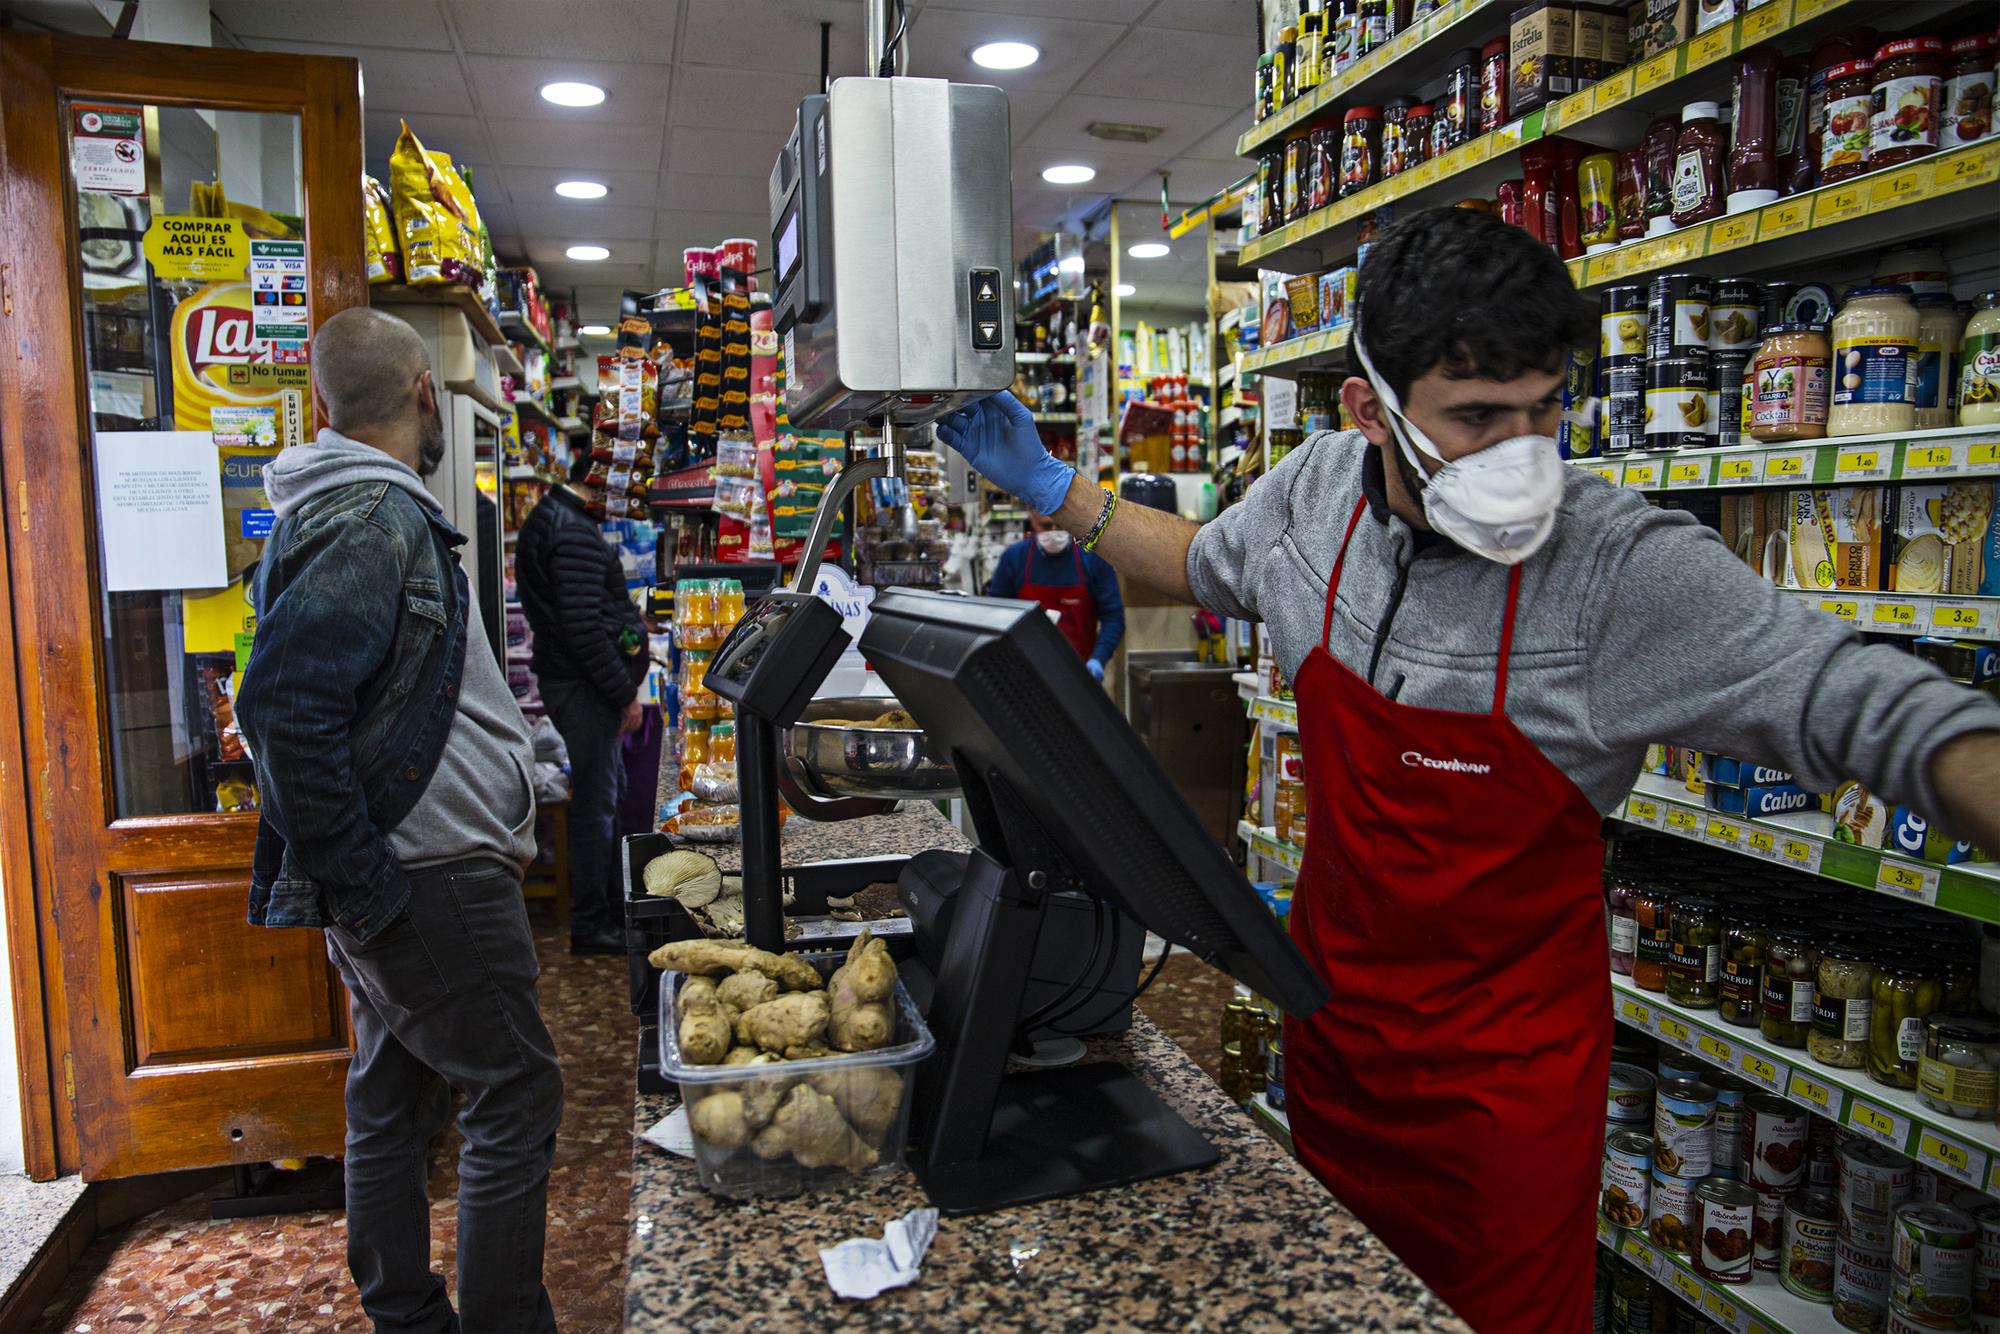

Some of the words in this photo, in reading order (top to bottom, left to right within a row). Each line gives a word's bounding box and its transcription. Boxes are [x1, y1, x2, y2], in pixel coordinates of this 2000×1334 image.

[1647, 0, 1678, 18] BON
[1522, 27, 1531, 36] La
[1512, 29, 1543, 52] Estrella
[1888, 42, 1914, 53] GALLO
[163, 221, 231, 233] COMPRAR
[170, 232, 206, 244] AQUÍ
[211, 235, 226, 245] ES
[162, 245, 193, 256] MÁS
[199, 245, 235, 258] FÁCIL
[252, 366, 269, 376] No
[272, 366, 307, 377] fumar
[277, 378, 307, 386] Gracias
[1755, 409, 1790, 421] Cocktail
[1848, 545, 1857, 586] BONITO
[1760, 792, 1807, 813] Calvo
[1870, 1113, 1885, 1129] 1.10
[1710, 1209, 1748, 1221] Albóndigas
